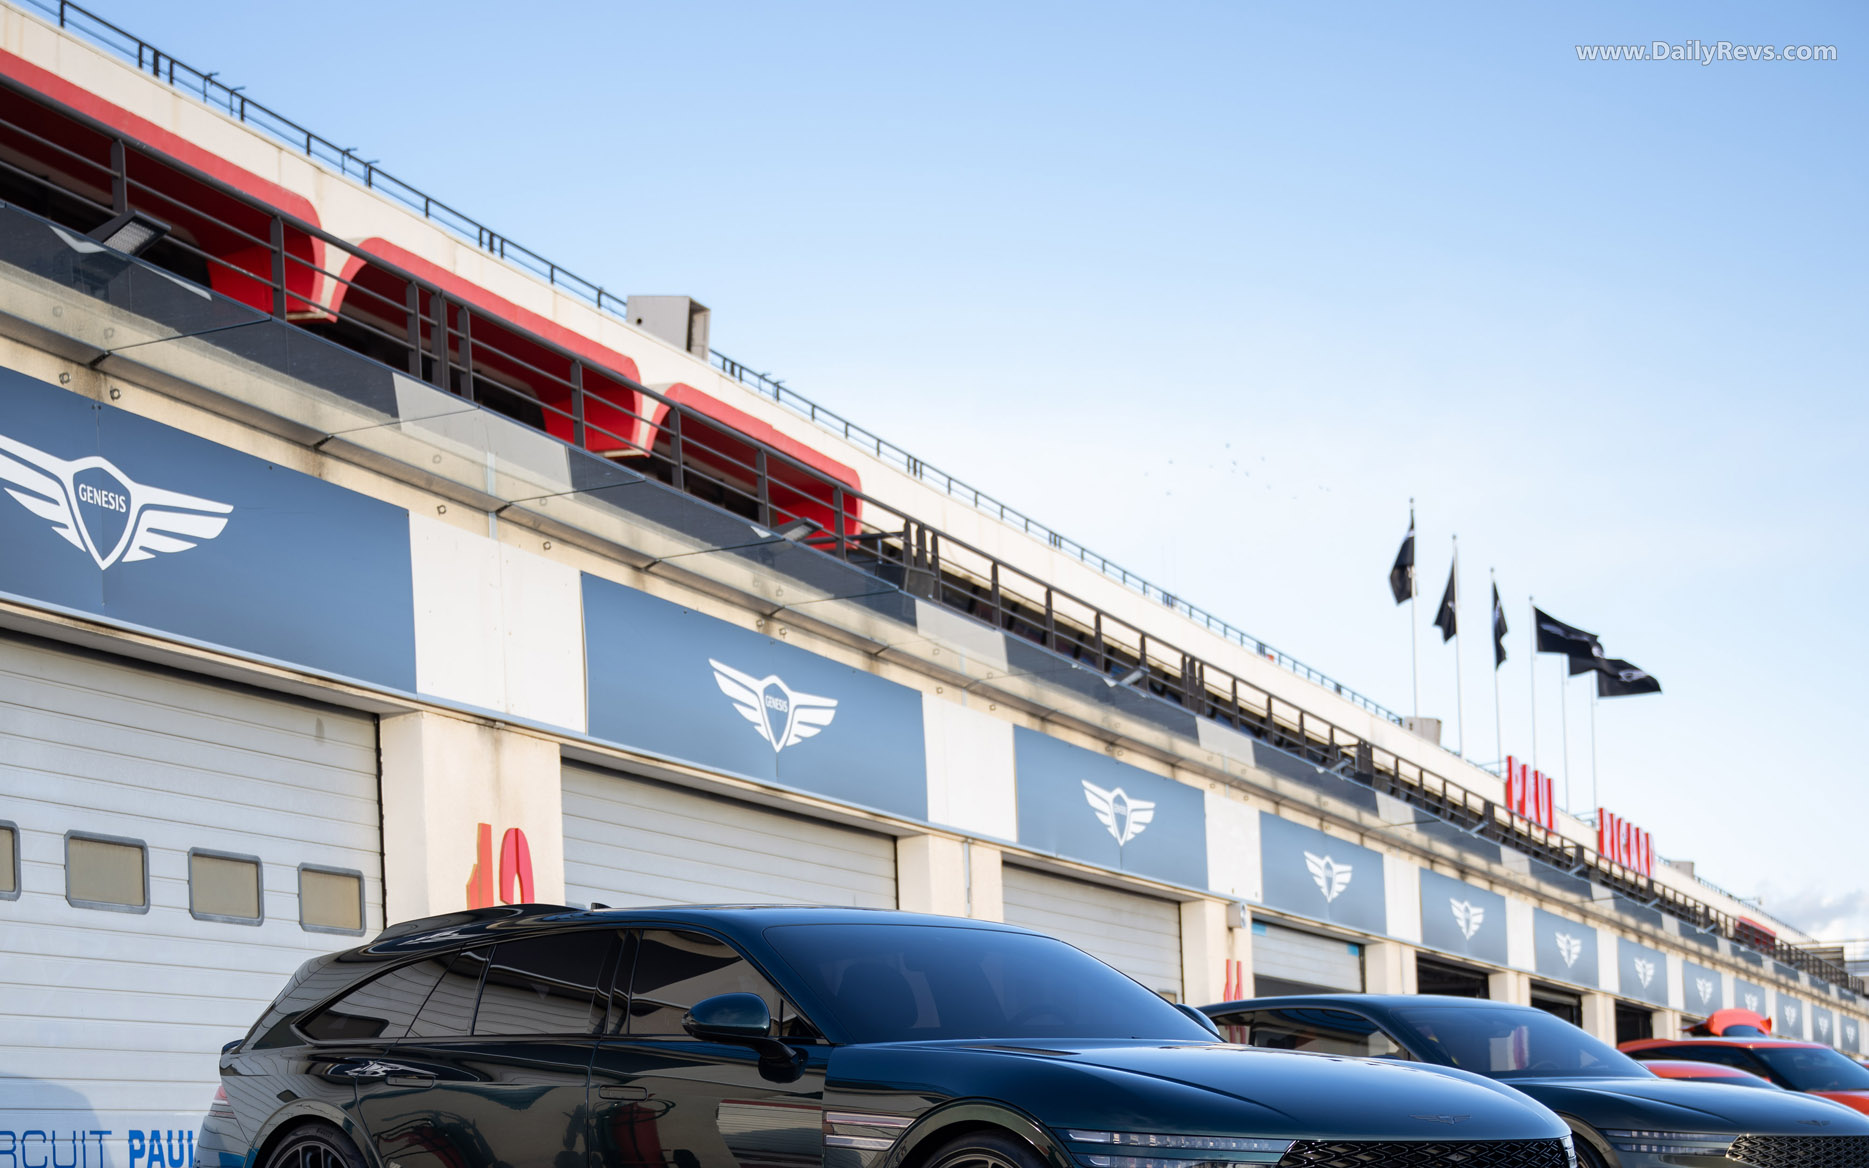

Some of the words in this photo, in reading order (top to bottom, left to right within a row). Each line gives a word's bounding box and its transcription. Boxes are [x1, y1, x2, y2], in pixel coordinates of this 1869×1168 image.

[78, 483, 127, 513] GENESIS
[1506, 755, 1559, 836] PAUL
[1598, 807, 1656, 884] RICARD
